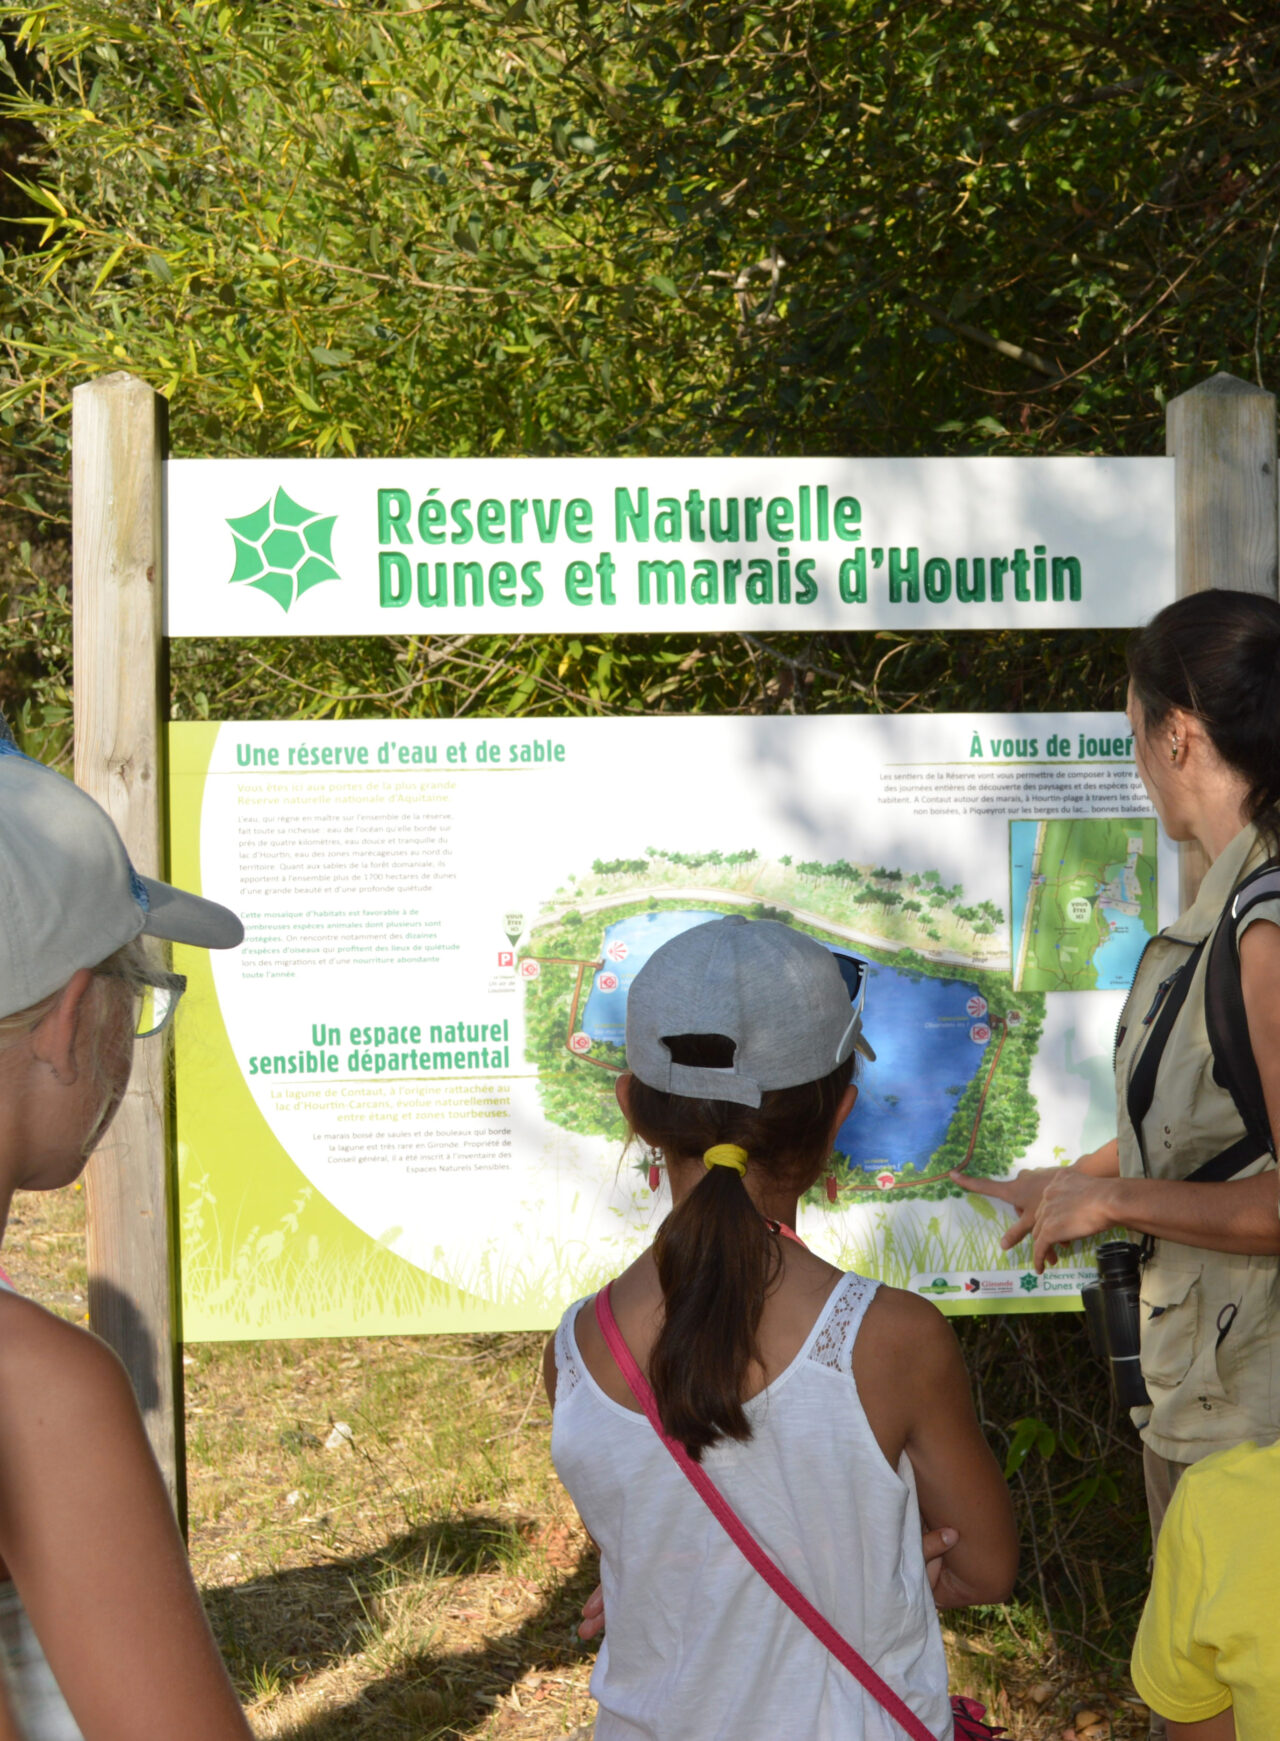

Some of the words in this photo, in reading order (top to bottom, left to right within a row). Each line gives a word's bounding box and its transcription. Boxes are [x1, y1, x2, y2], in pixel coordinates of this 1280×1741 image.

[376, 486, 592, 546] Réserve
[614, 484, 862, 544] Naturelle
[377, 549, 544, 610] Dunes
[564, 552, 616, 608] et
[637, 546, 820, 607] marais
[840, 545, 1083, 606] d'Hourtin
[236, 742, 279, 768] Une
[287, 741, 368, 767] réserve
[377, 740, 437, 766] d'eau
[446, 742, 466, 765] et
[475, 740, 500, 764] de
[509, 739, 566, 764] sable
[969, 730, 983, 758] À
[991, 739, 1039, 758] vous
[1046, 734, 1071, 757] de
[1077, 733, 1133, 759] jouer
[880, 772, 892, 781] Les
[893, 772, 923, 780] sentiers
[925, 771, 935, 780] de
[936, 771, 944, 780] la
[945, 771, 975, 780] Réserve
[977, 771, 994, 780] vont
[1014, 770, 1055, 781] permettre
[1054, 770, 1066, 779] de
[1066, 772, 1106, 780] composer
[1112, 769, 1134, 778] votre
[312, 1023, 340, 1048] Un
[350, 1026, 421, 1048] espace
[429, 1019, 510, 1043] naturel
[249, 1050, 339, 1075] sensible
[348, 1046, 510, 1074] départemental
[270, 1089, 282, 1099] La
[285, 1088, 321, 1100] lagune
[323, 1088, 337, 1098] de
[340, 1086, 385, 1099] Contaut,
[398, 1085, 441, 1098] l'origine
[444, 1084, 496, 1095] rattachée
[495, 1086, 510, 1094] au
[276, 1101, 290, 1111] lac
[292, 1099, 392, 1113] d'Hourtin-Carcans,
[396, 1098, 432, 1108] évolue
[434, 1096, 510, 1107] naturellement
[337, 1112, 365, 1122] entre
[368, 1111, 398, 1123] étang
[401, 1111, 412, 1120] et
[415, 1112, 445, 1120] zones
[447, 1108, 512, 1119] tourbeuses.
[1044, 1282, 1072, 1290] Dunes
[1076, 1282, 1084, 1290] et
